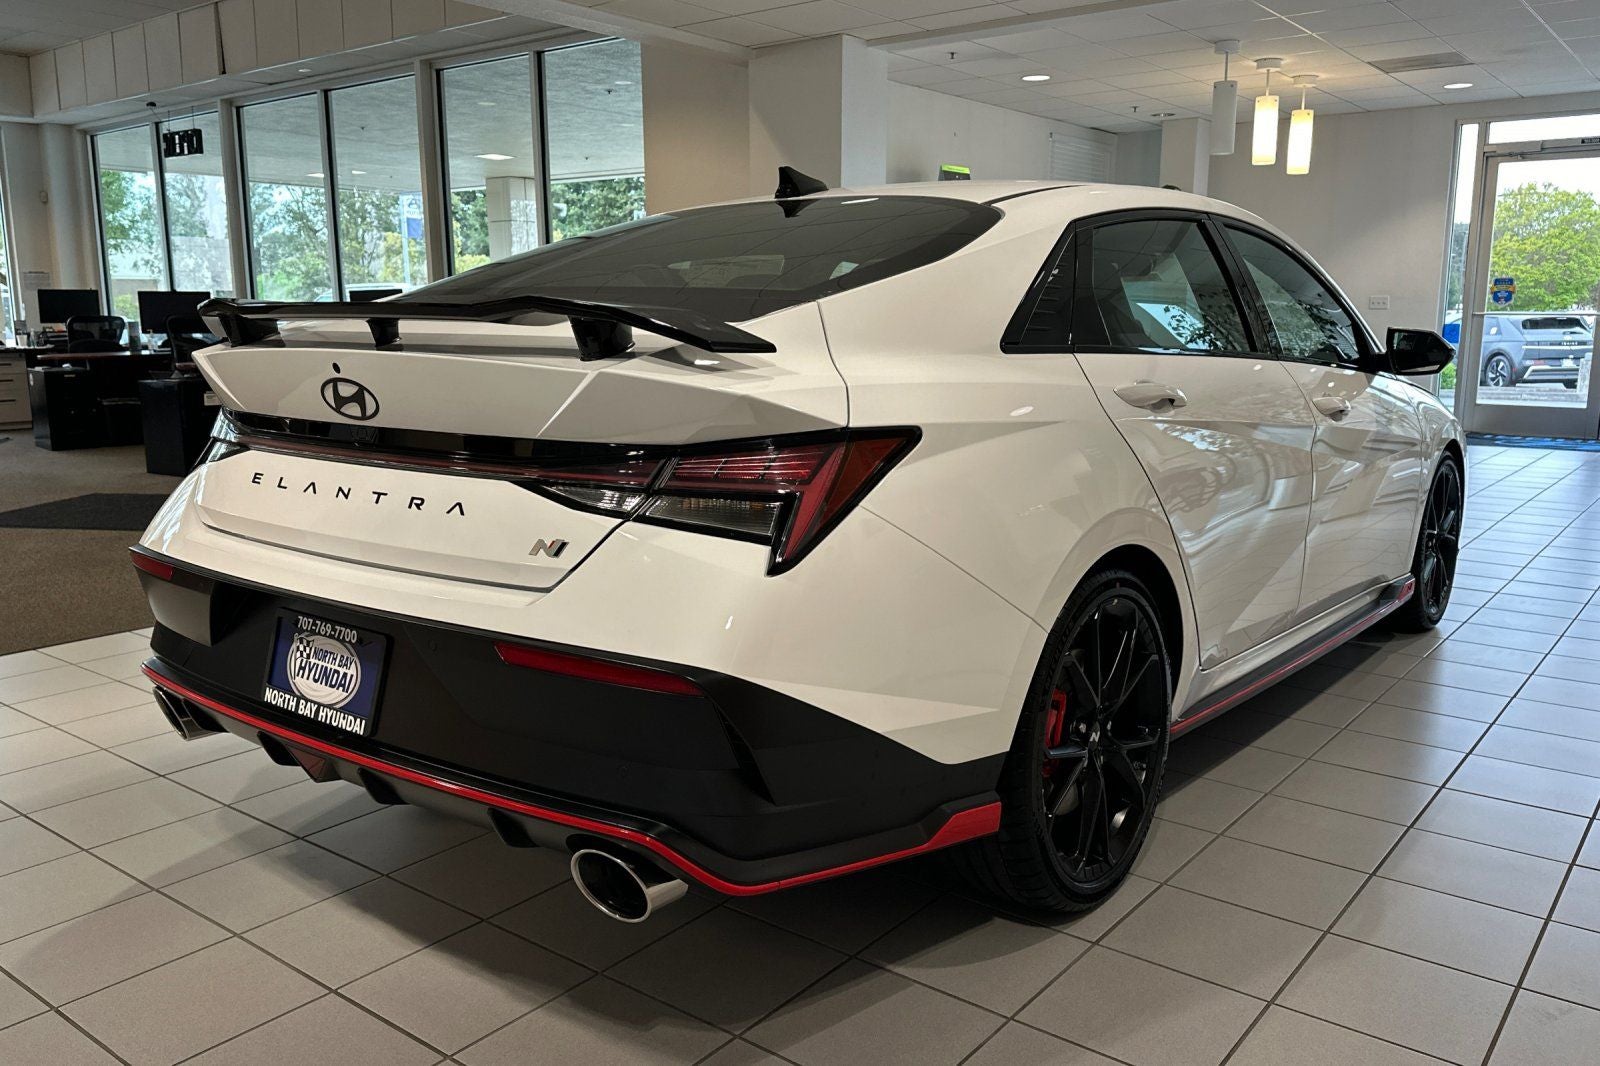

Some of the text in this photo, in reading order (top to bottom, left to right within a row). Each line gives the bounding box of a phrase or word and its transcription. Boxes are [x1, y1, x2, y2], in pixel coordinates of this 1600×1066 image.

[251, 472, 466, 516] ELANTRA
[297, 616, 358, 644] 707-769-7700
[312, 646, 355, 671] NORTH BAY
[296, 659, 354, 694] HYUNDAI
[264, 687, 366, 736] NORTH BAY HYUNDAI
